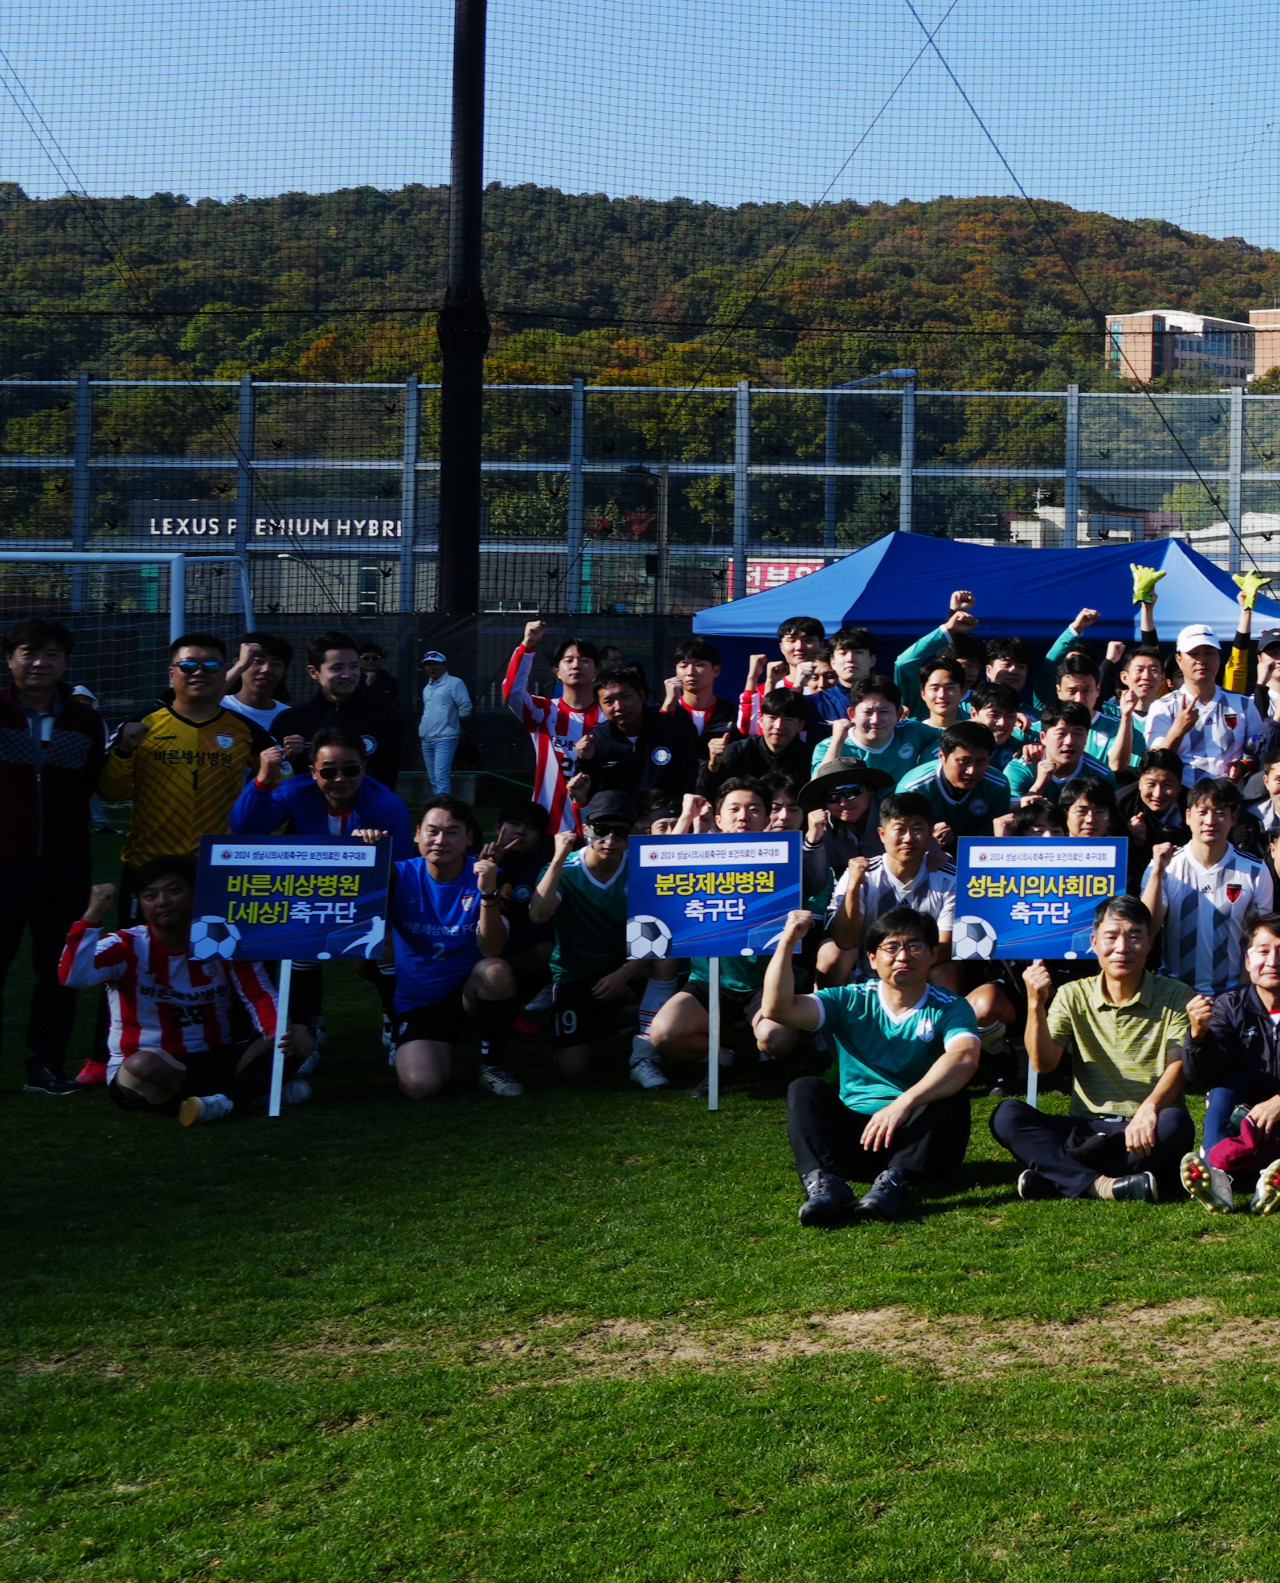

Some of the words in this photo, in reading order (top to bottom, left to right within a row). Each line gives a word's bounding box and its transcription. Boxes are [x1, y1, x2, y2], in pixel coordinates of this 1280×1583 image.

[150, 518, 220, 535] LEXUS
[227, 518, 329, 537] PEMIUM
[336, 519, 402, 537] HYBRI
[154, 749, 232, 768] 바른세상병원
[190, 769, 199, 790] 1
[234, 851, 250, 860] 2024
[227, 874, 360, 897] 바른세상병원
[654, 870, 775, 896] 분당제생병원
[966, 874, 1115, 898] 성남시의사회[B]
[227, 900, 357, 924] [세상]축구단
[684, 897, 746, 922] 축구단
[1010, 901, 1071, 925] 축구단
[431, 942, 446, 961] 2
